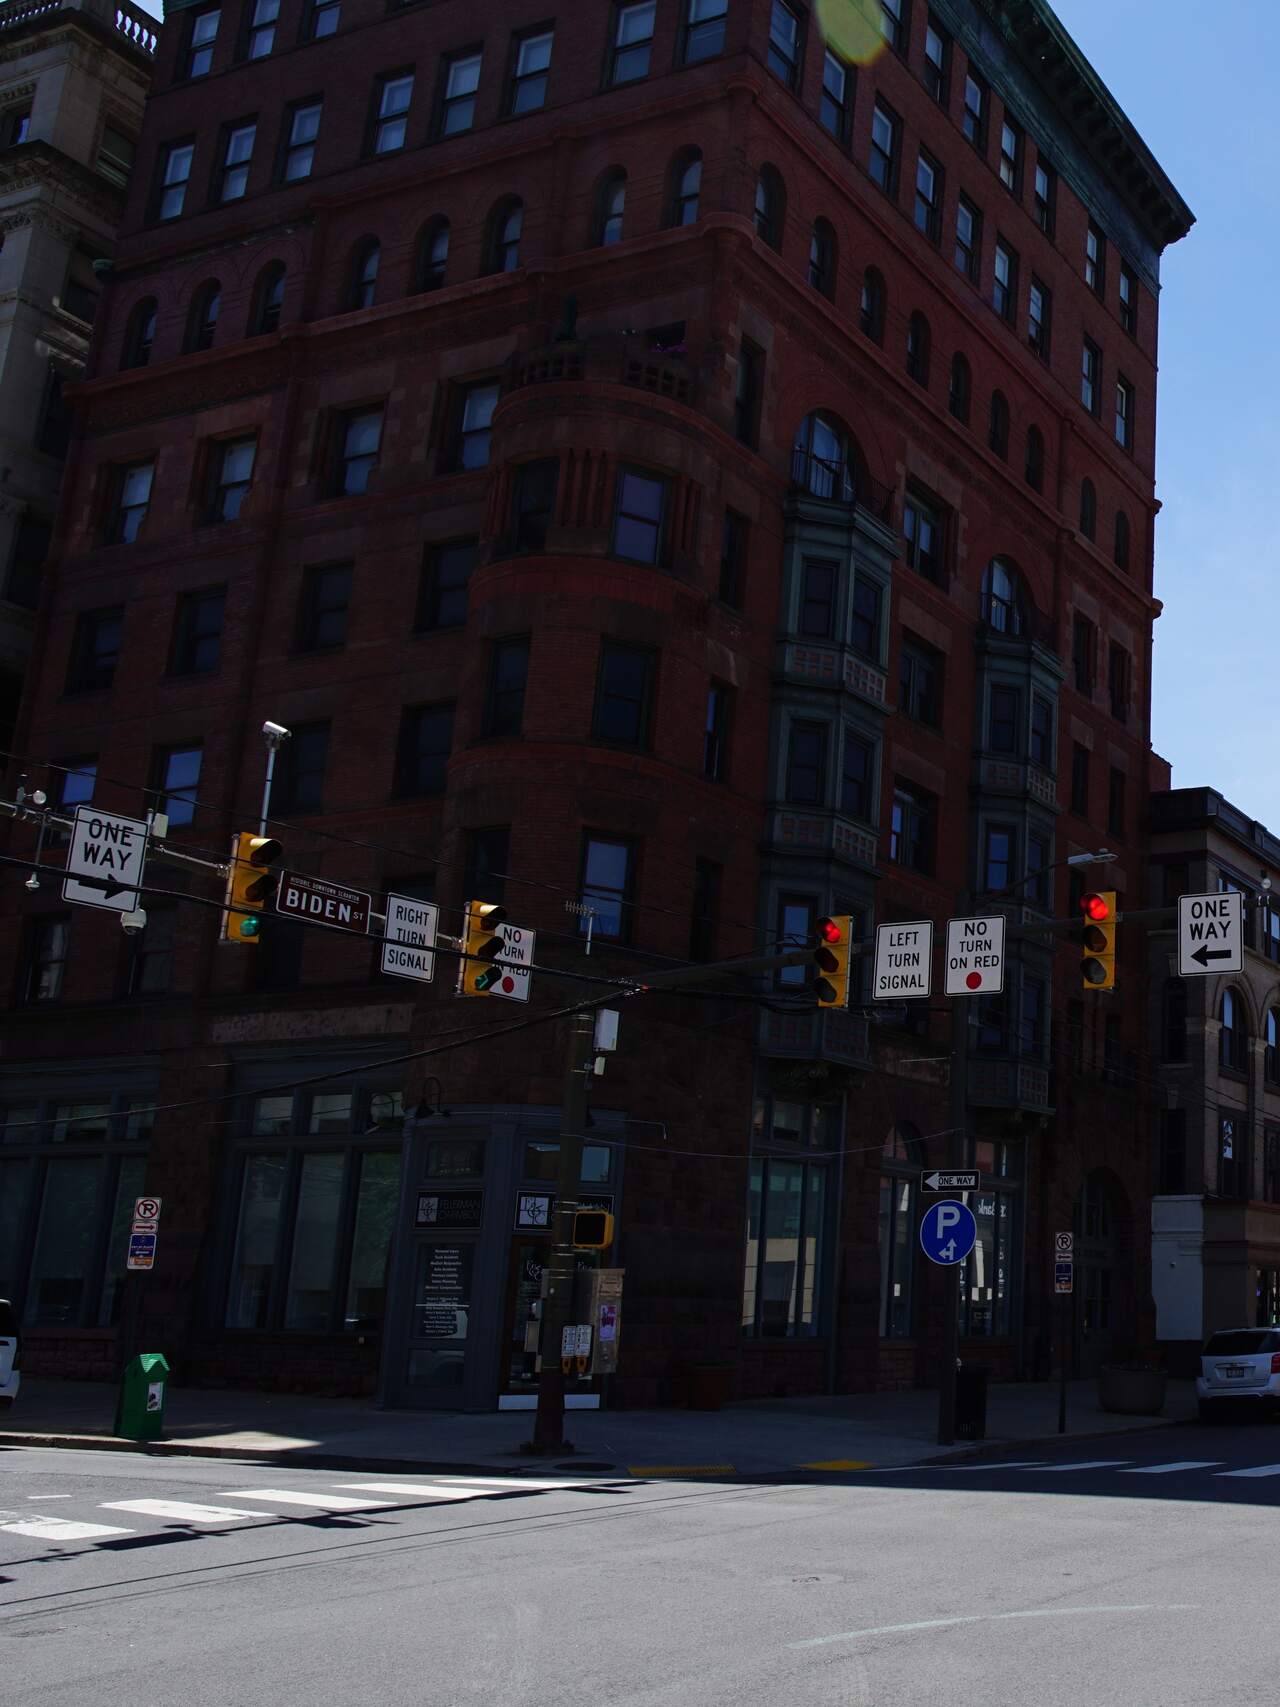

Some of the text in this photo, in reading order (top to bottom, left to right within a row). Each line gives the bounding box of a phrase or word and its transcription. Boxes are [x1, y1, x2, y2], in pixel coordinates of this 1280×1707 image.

[89, 818, 134, 847] ONE
[84, 842, 132, 870] WAY
[286, 888, 364, 923] BIDEN ST
[1191, 899, 1230, 919] ONE
[396, 905, 429, 926] RIGHT
[397, 927, 426, 946] TURN
[503, 926, 522, 944] NO
[964, 921, 987, 937] NO
[1189, 920, 1231, 941] WAY
[890, 931, 919, 947] LEFT
[959, 939, 992, 953] TURN
[388, 949, 429, 972] SIGNAL
[500, 945, 525, 960] URN
[888, 952, 920, 968] TURN
[950, 955, 1000, 970] ON RED
[880, 974, 925, 990] SIGNAL
[938, 1176, 973, 1186] ONE WAY
[936, 1205, 961, 1239] P
